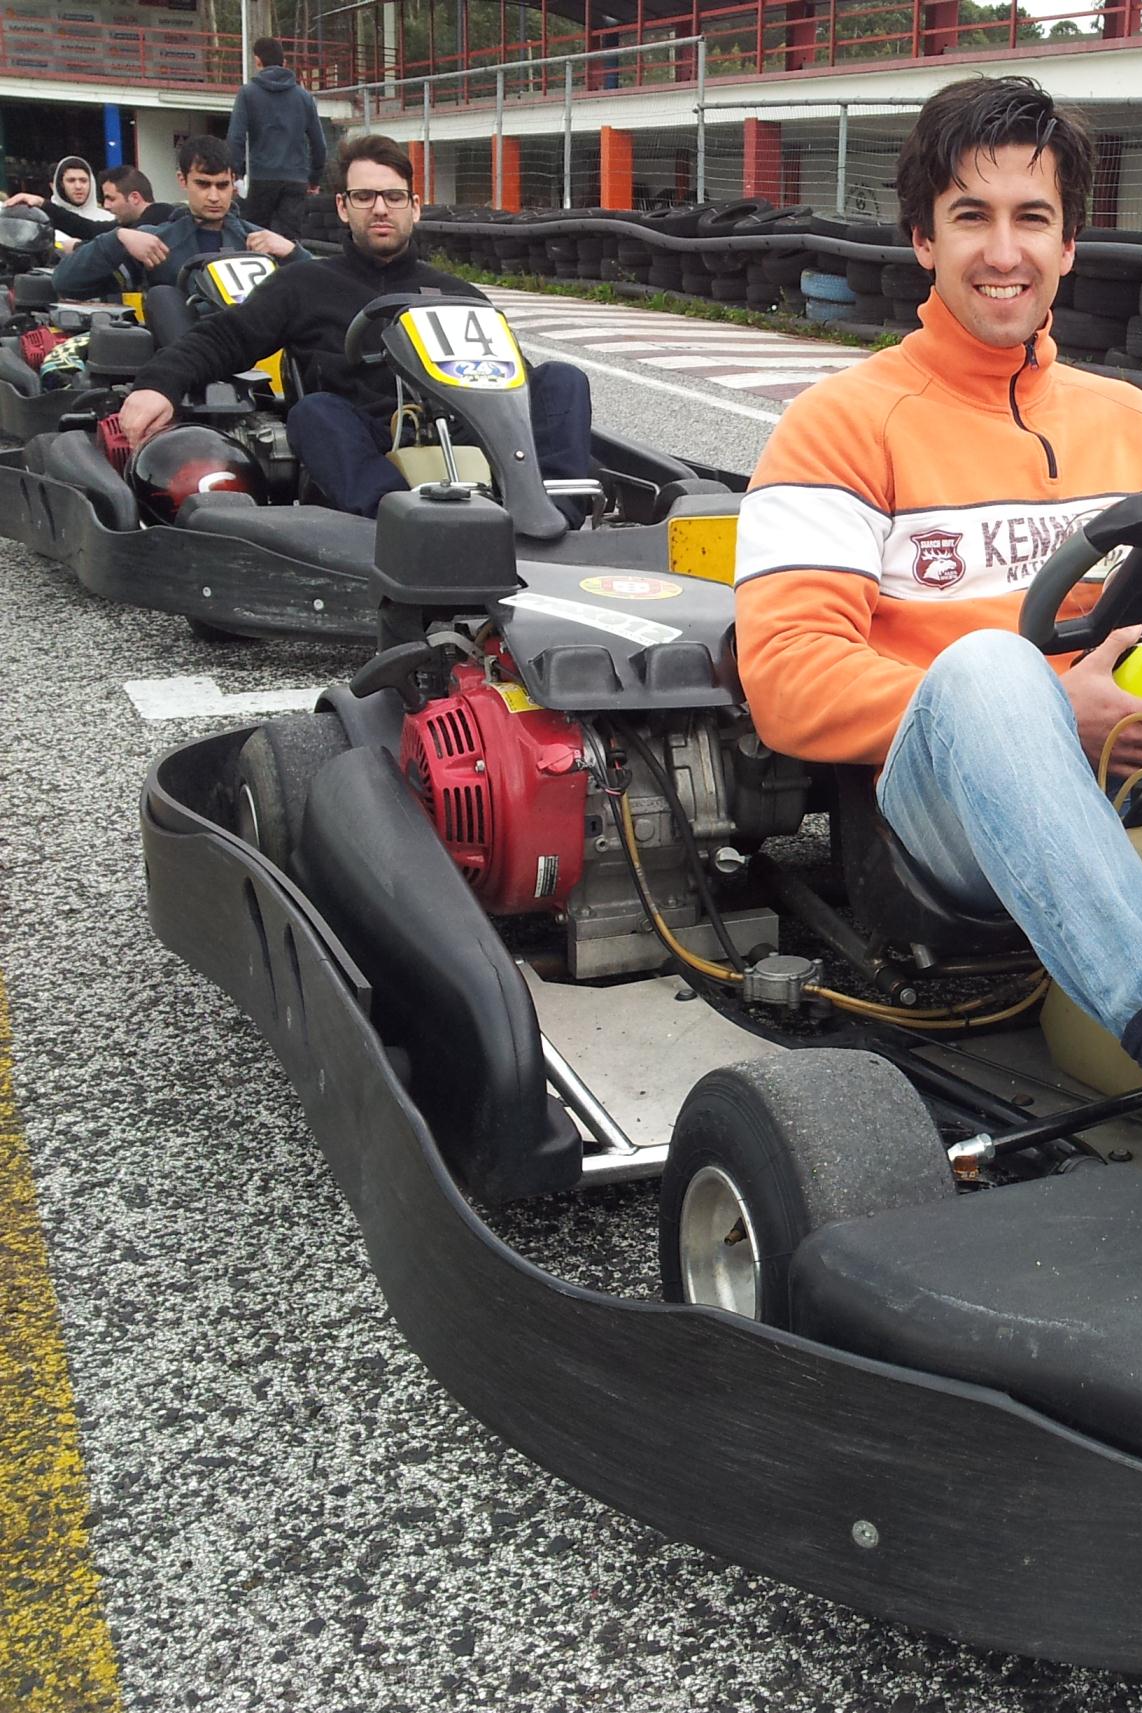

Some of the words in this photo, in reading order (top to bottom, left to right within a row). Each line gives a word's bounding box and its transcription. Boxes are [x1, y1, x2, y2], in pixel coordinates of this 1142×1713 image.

[225, 261, 267, 290] 12
[426, 310, 498, 358] 14
[981, 514, 1084, 568] KENN
[1006, 559, 1044, 583] NAT
